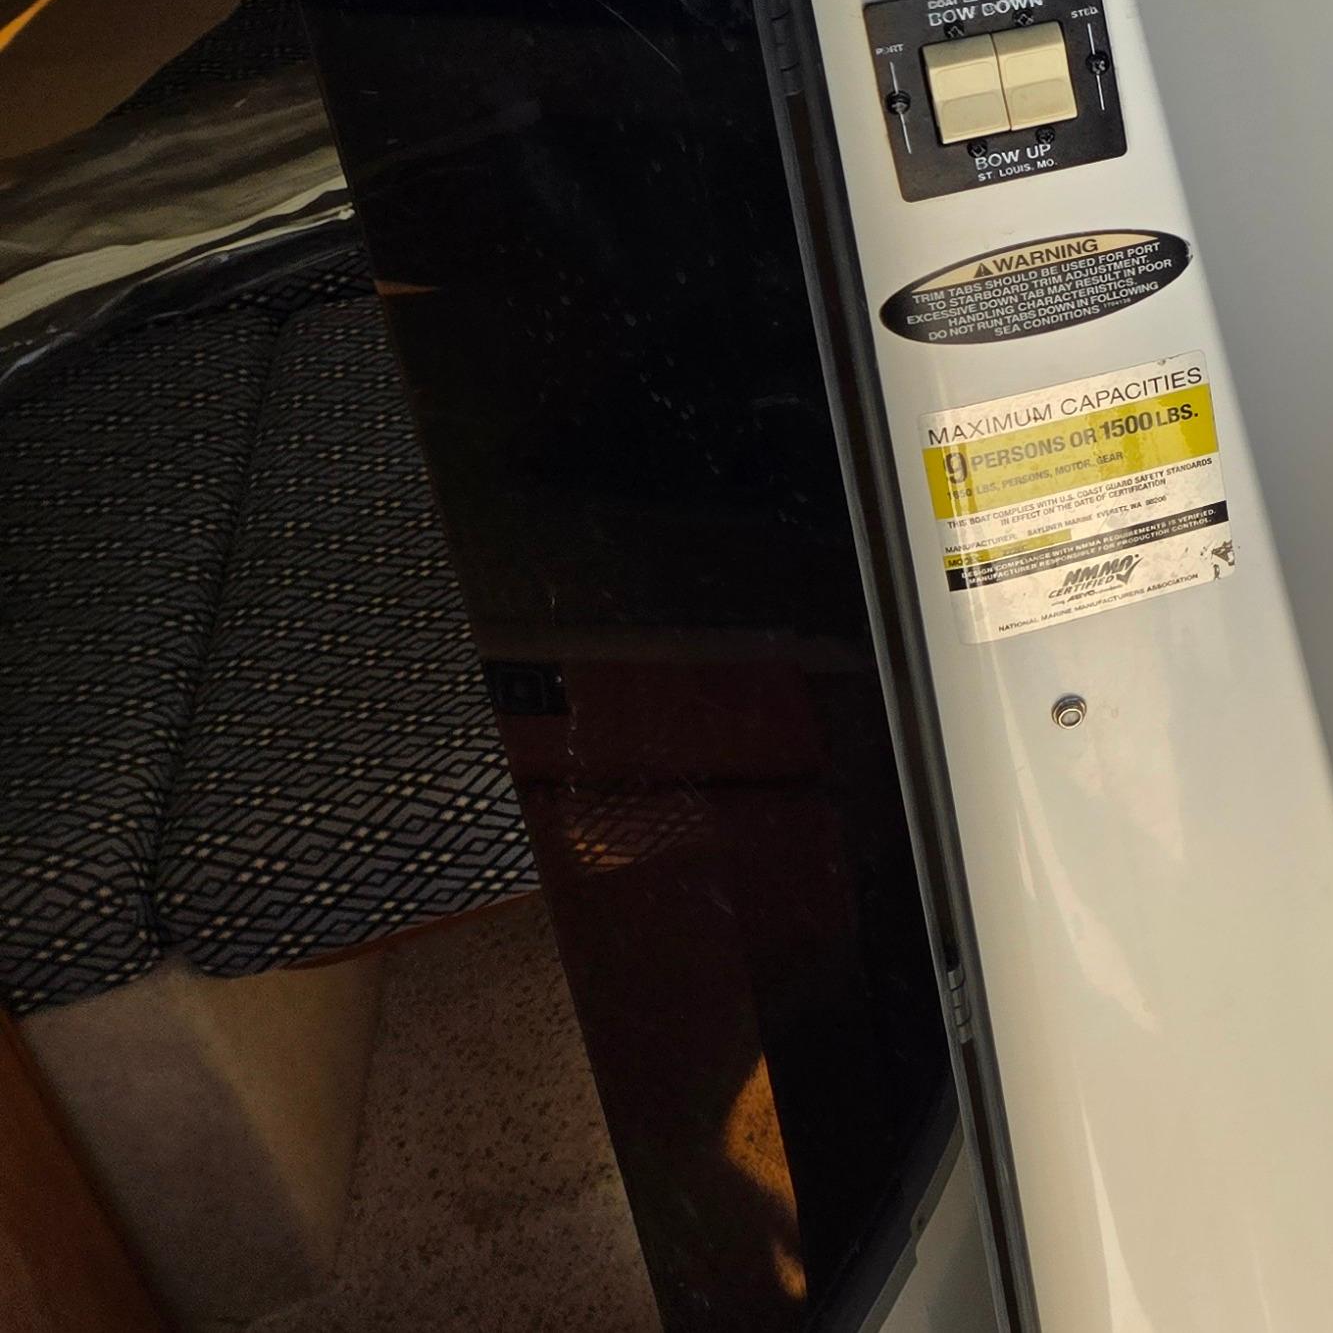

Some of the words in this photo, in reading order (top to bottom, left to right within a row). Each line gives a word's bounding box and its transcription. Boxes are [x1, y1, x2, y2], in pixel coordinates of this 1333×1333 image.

[928, 7, 976, 27] BOW
[975, 150, 1020, 170] BOW
[1026, 144, 1052, 160] UP
[912, 290, 945, 304] TRIM
[948, 282, 982, 297] TABS
[984, 270, 1038, 286] SHOULD
[1040, 266, 1059, 276] BE
[1062, 258, 1096, 272] USED
[1098, 251, 1124, 264] FOR
[1127, 242, 1160, 257] PORT
[992, 239, 1099, 272] WARNING
[906, 302, 977, 326] EXCESSIVE
[979, 294, 1019, 313] DOWN
[1021, 288, 1044, 301] TAB
[1046, 282, 1074, 296] MAY
[1075, 270, 1122, 289] RESULT
[1123, 268, 1136, 278] IN
[1138, 258, 1172, 275] POOR
[928, 300, 946, 312] TO
[949, 283, 1030, 308] STARBOARD
[1032, 274, 1062, 288] TRIM
[1065, 254, 1150, 282] ADJUSTMENT.
[948, 306, 1015, 328] HANDLING
[1018, 278, 1138, 312] CHARACTERISTICS.
[928, 329, 948, 341] DO
[949, 324, 976, 337] NOT
[977, 318, 1004, 332] RUN
[1005, 311, 1037, 326] TABS
[1038, 300, 1076, 317] DOWN
[1076, 298, 1089, 308] IN
[1090, 280, 1160, 306] FOLLOWING
[994, 324, 1022, 337] SEA
[1022, 304, 1100, 331] CONDITIONS
[928, 402, 1053, 446] MAXIMUM
[1060, 366, 1202, 417] CAPACITIES
[944, 450, 968, 486] 9
[970, 434, 1066, 472] PERSONS
[1069, 426, 1098, 448] OR
[1099, 412, 1154, 442] 1500
[1154, 402, 1199, 427] LBS.
[1096, 452, 1124, 465] GEAR
[947, 518, 968, 529] THIS
[970, 514, 992, 526] BOAT
[992, 503, 1034, 520] COMPLIES
[1036, 498, 1058, 510] WITH
[1060, 494, 1075, 502] U.S.
[1077, 486, 1103, 499] COAST
[1106, 478, 1134, 491] GUARD
[1135, 470, 1164, 484] SAFETY
[1166, 458, 1213, 476] STANDARDS
[1000, 517, 1010, 526] IN
[1012, 510, 1042, 523] EFFECT
[1043, 506, 1055, 516] ON
[1057, 502, 1073, 512] THE
[1074, 496, 1095, 507] DATE
[1096, 492, 1108, 502] OF
[1109, 478, 1167, 498] CERTIFICATION
[1130, 501, 1142, 510] WA
[969, 564, 1038, 584] MANUFACTURER
[1038, 546, 1096, 568] RESPONSIBLE
[1116, 528, 1170, 546] PRODUCTION
[994, 552, 1052, 571] COMPLIANCE
[1052, 548, 1074, 557] WITH
[1103, 522, 1167, 544] REQUIREMENTS
[1168, 518, 1177, 526] IS
[998, 618, 1038, 632] NATIONAL
[1041, 608, 1072, 622] MARINE
[1074, 588, 1145, 612] MANUFACTURERS
[1146, 573, 1198, 592] ASSOCIATION
[1048, 574, 1114, 598] CERTIFIED
